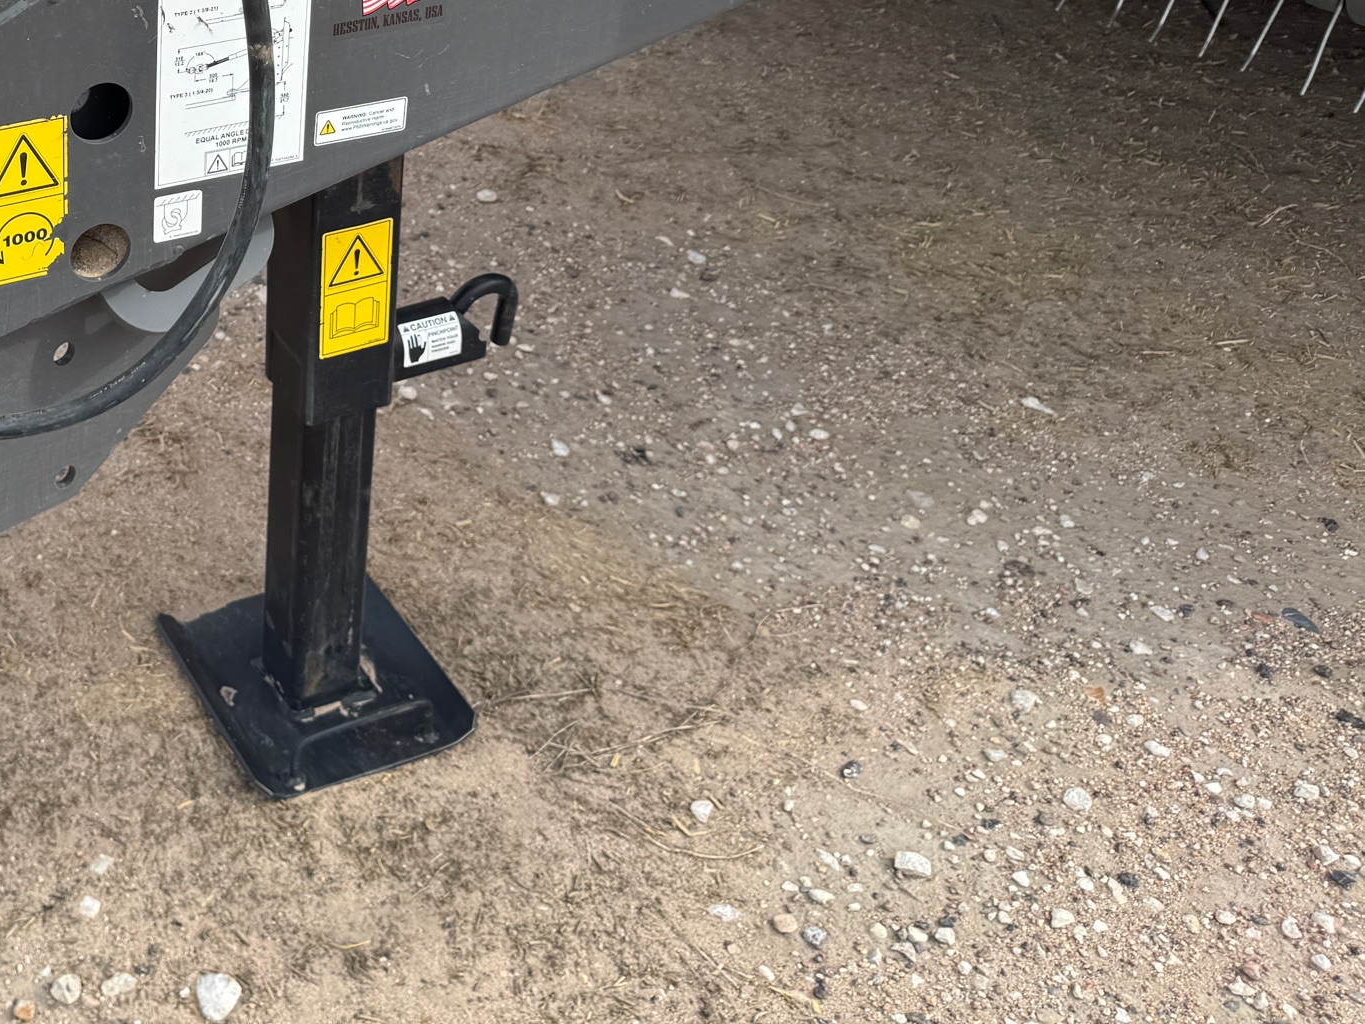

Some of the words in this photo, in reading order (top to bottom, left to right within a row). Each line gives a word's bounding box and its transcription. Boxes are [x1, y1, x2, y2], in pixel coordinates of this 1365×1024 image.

[332, 16, 380, 37] HESSTON,
[383, 8, 422, 27] KANSAS,
[425, 4, 443, 19] USA
[195, 135, 220, 145] EQUAL
[220, 131, 244, 140] ANGLE
[215, 139, 231, 148] 1000
[232, 137, 247, 145] RPM
[3, 227, 48, 248] 1000
[410, 315, 448, 332] CAUTION
